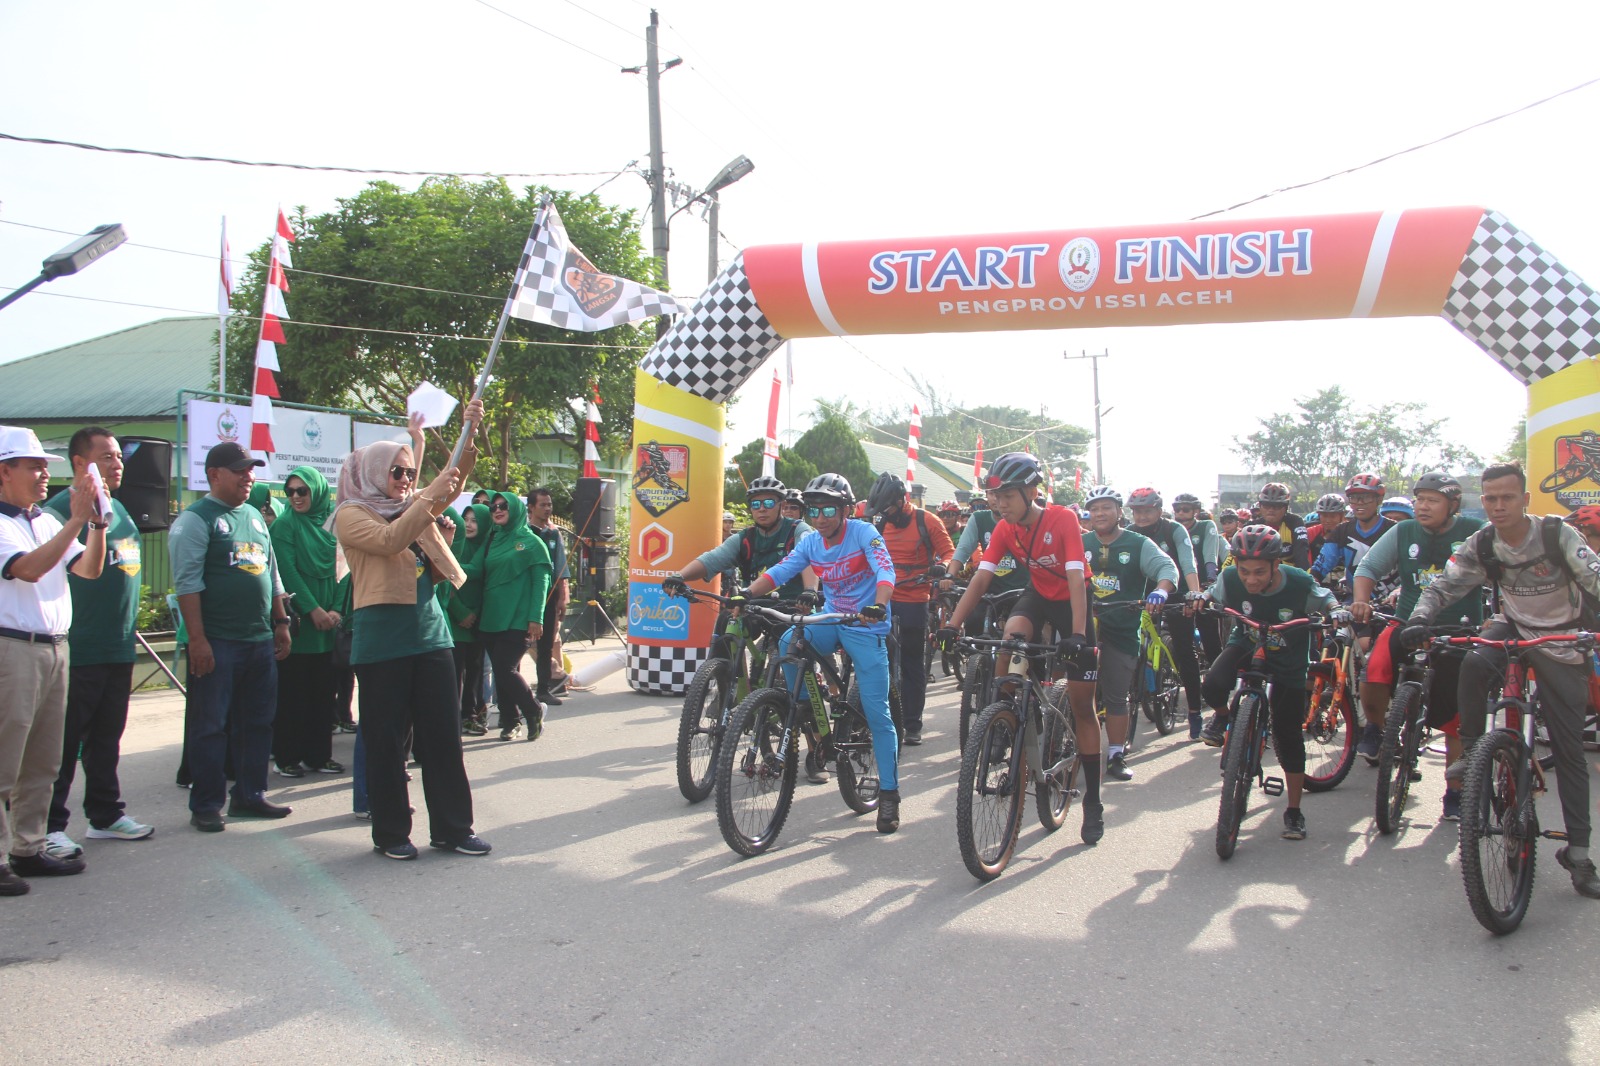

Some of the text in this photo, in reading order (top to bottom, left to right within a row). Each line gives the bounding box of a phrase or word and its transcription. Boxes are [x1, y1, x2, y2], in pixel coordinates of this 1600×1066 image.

[868, 244, 1049, 294] START
[1114, 229, 1312, 284] FINISH
[584, 293, 617, 312] LANGSA
[939, 290, 1233, 315] PENGPROV ISSI ACEH
[331, 457, 346, 465] KIRAN
[631, 595, 681, 621] Serikat
